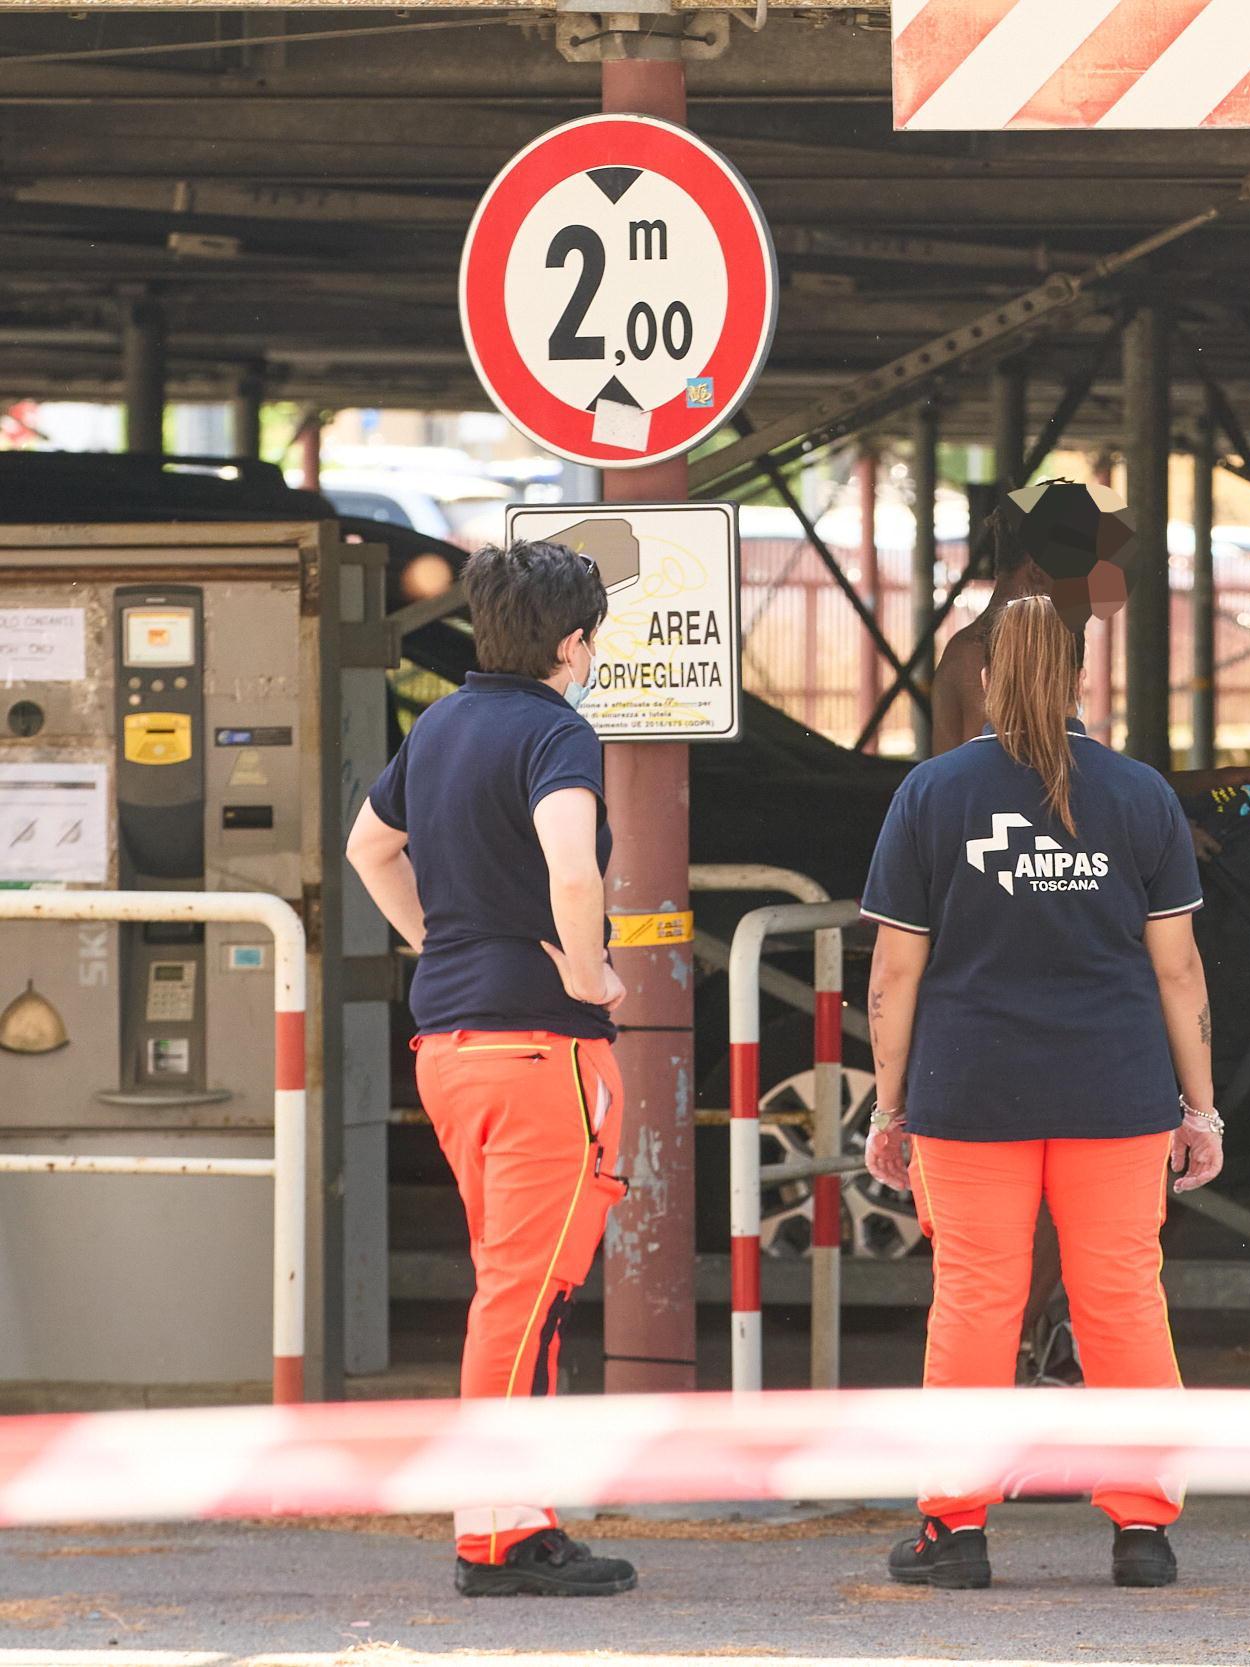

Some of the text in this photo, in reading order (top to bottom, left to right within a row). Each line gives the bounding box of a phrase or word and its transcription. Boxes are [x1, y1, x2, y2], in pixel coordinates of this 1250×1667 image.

[629, 219, 668, 260] m
[648, 610, 721, 646] AREA
[593, 720, 627, 729] olamento
[1015, 852, 1109, 878] ANPAS
[1030, 879, 1099, 892] TOSCANA
